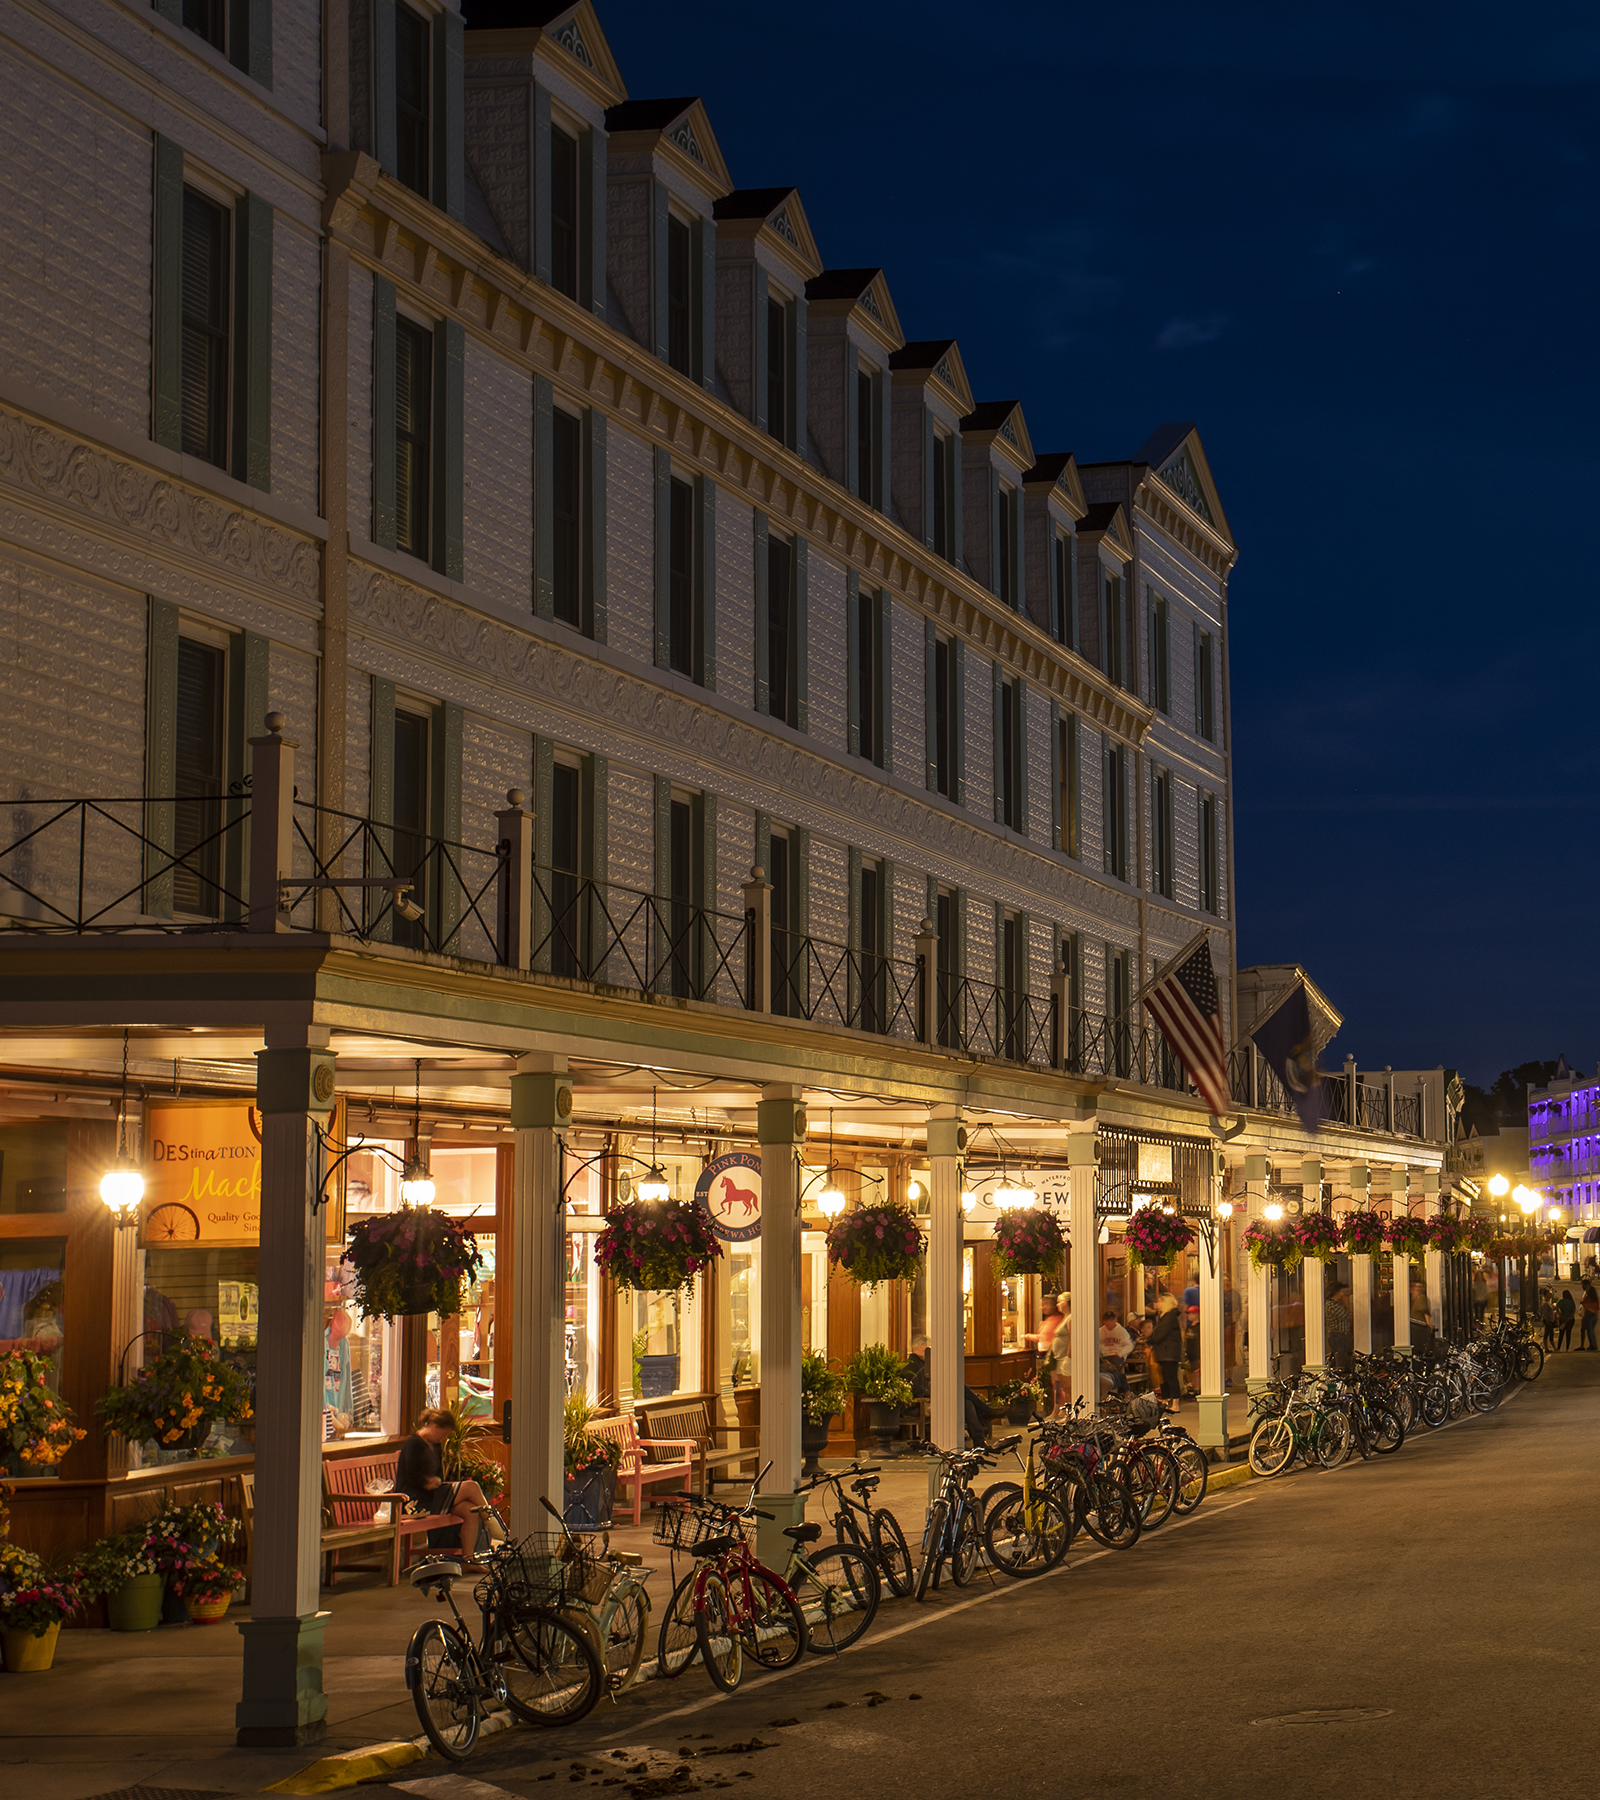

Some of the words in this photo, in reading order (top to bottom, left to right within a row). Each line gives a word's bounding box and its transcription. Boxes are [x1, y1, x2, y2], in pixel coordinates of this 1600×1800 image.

[708, 1156, 738, 1176] PINK
[740, 1154, 762, 1171] PON
[179, 1159, 263, 1202] Mack
[207, 1211, 240, 1224] Quality
